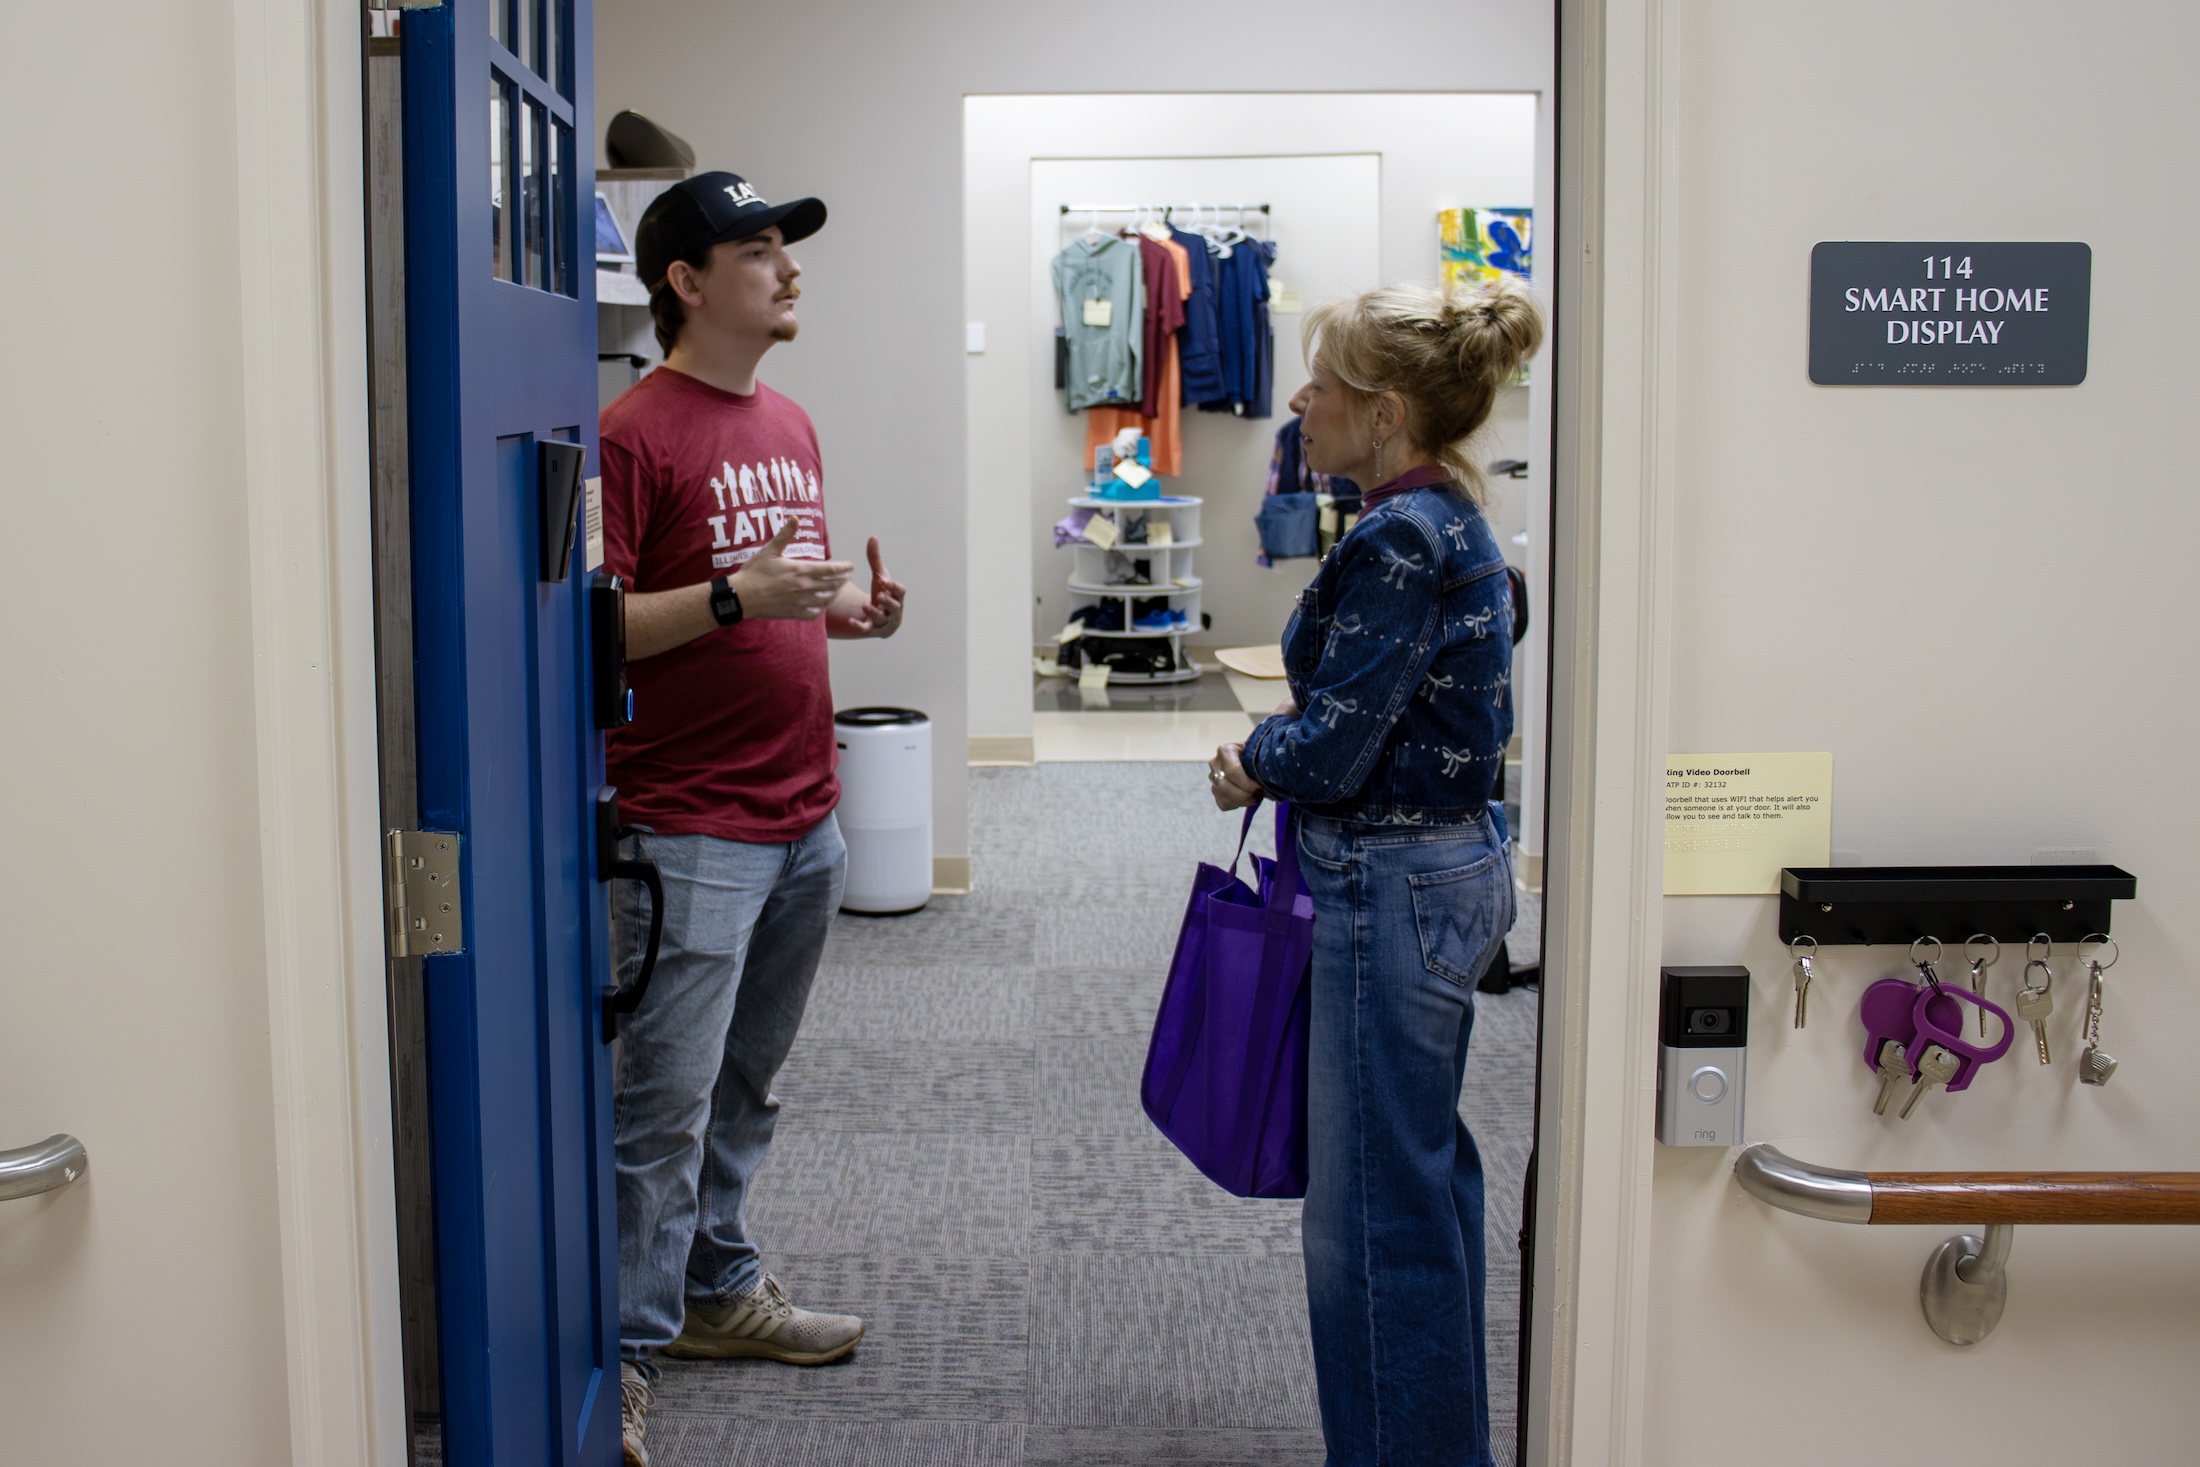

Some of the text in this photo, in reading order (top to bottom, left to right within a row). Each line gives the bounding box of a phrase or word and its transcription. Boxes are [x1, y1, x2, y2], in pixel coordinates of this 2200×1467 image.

[1922, 256, 1973, 280] 114
[1844, 287, 2049, 312] SMART HOME
[1886, 320, 2005, 344] DISPLAY
[707, 506, 784, 549] IATP
[1686, 768, 1711, 776] Video
[1713, 768, 1750, 776] Doorbell
[1765, 795, 1785, 803] helps
[1694, 1128, 1716, 1142] ring
